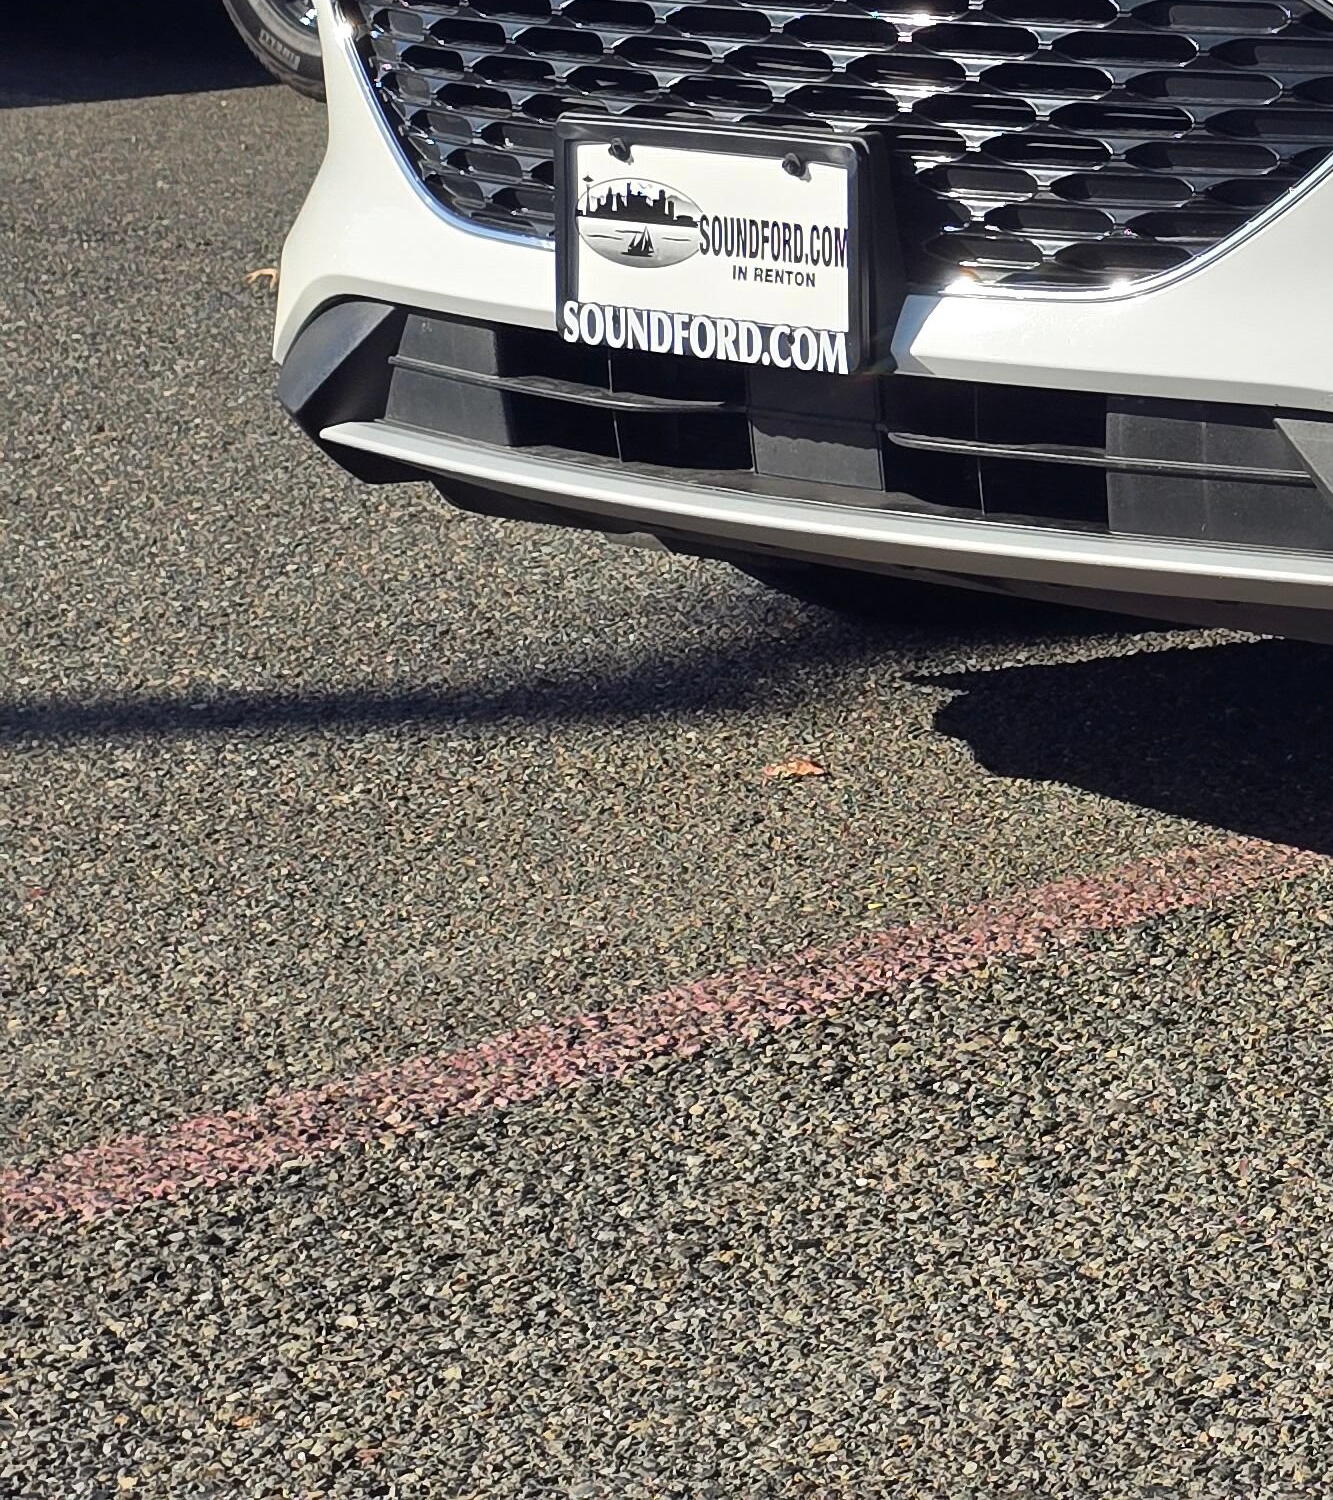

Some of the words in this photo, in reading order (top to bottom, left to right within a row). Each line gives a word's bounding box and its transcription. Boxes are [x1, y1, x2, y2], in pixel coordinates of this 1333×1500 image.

[699, 214, 849, 269] SOUNDFORD.COM
[732, 265, 748, 281] IN
[754, 267, 816, 288] RENTON
[563, 300, 849, 375] SOUNDFORD.COM
